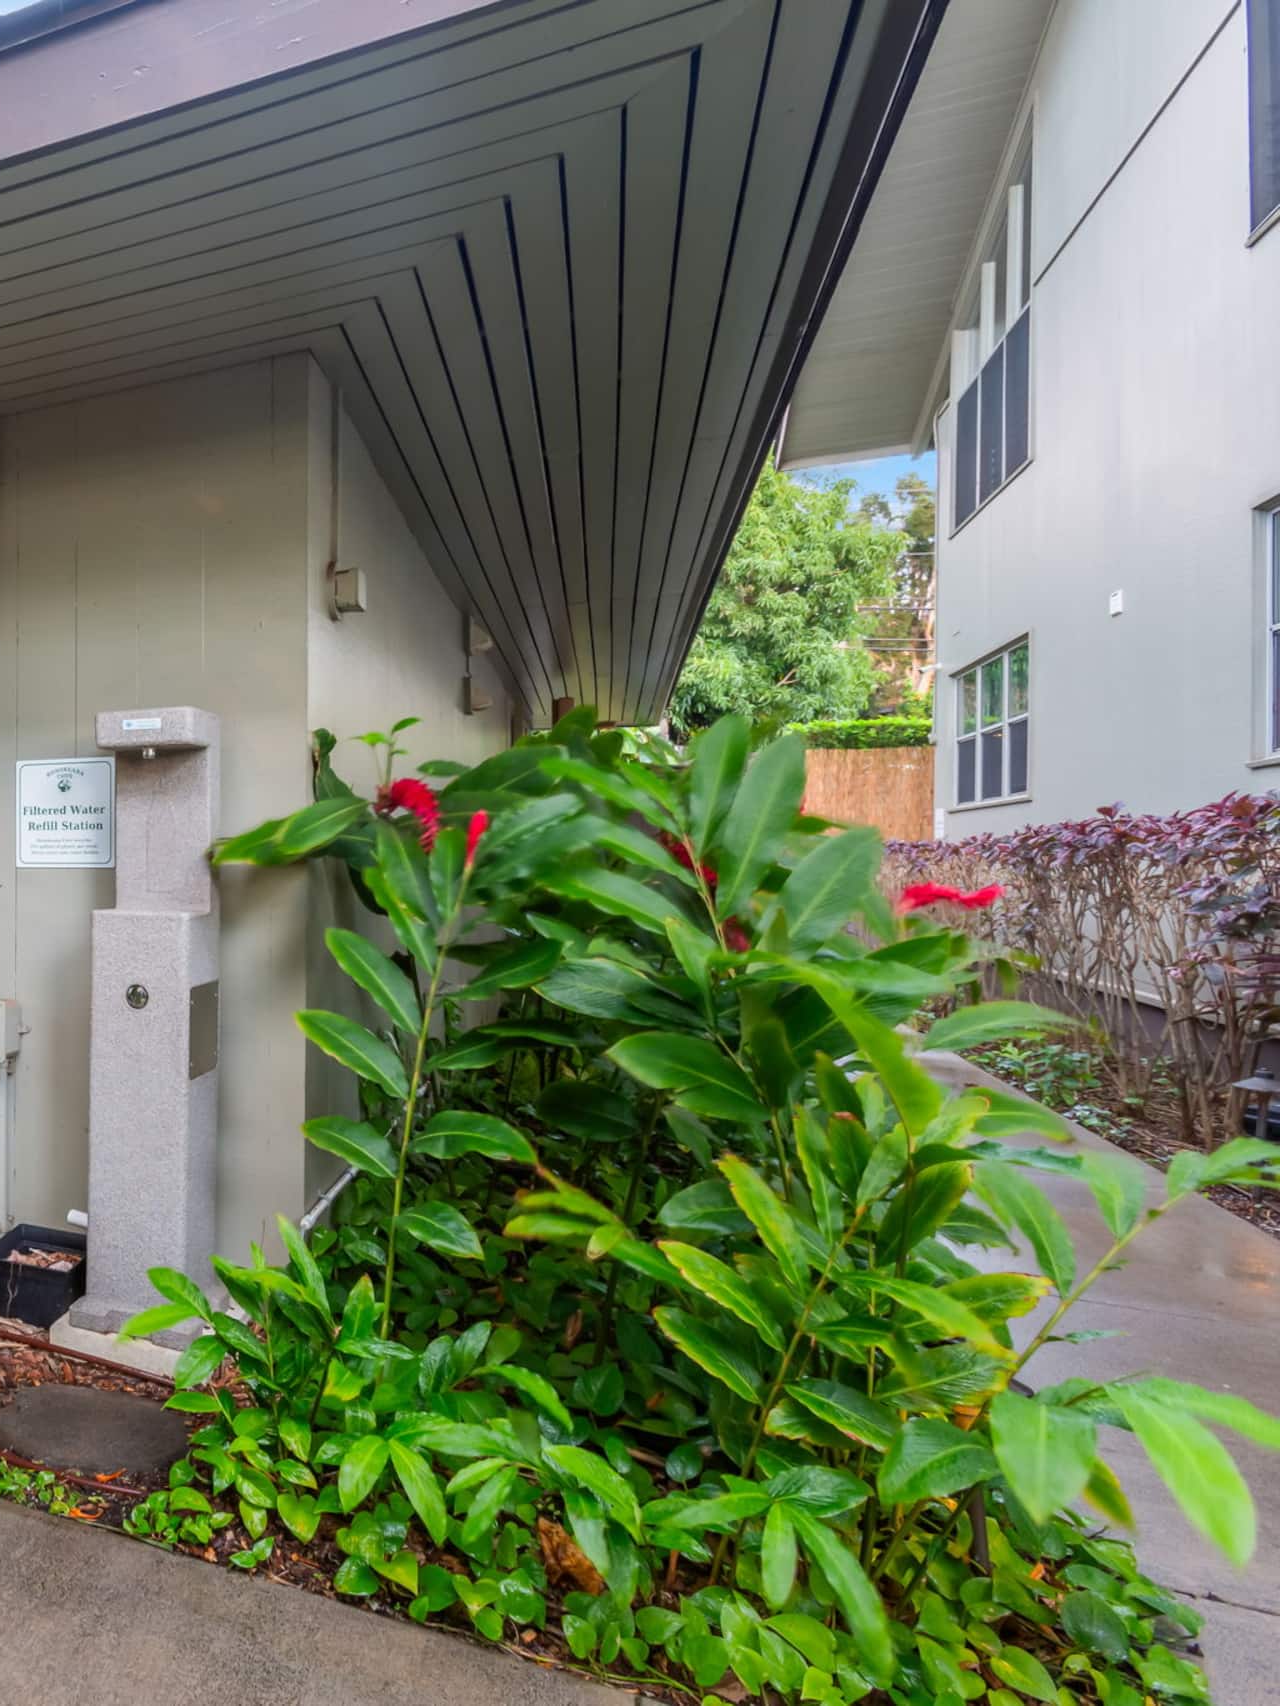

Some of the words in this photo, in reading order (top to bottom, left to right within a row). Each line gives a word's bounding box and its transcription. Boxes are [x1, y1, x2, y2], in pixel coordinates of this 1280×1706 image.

[23, 805, 67, 816] Filtered
[69, 805, 106, 815] Water
[28, 821, 58, 831] Refill
[61, 821, 104, 831] Station
